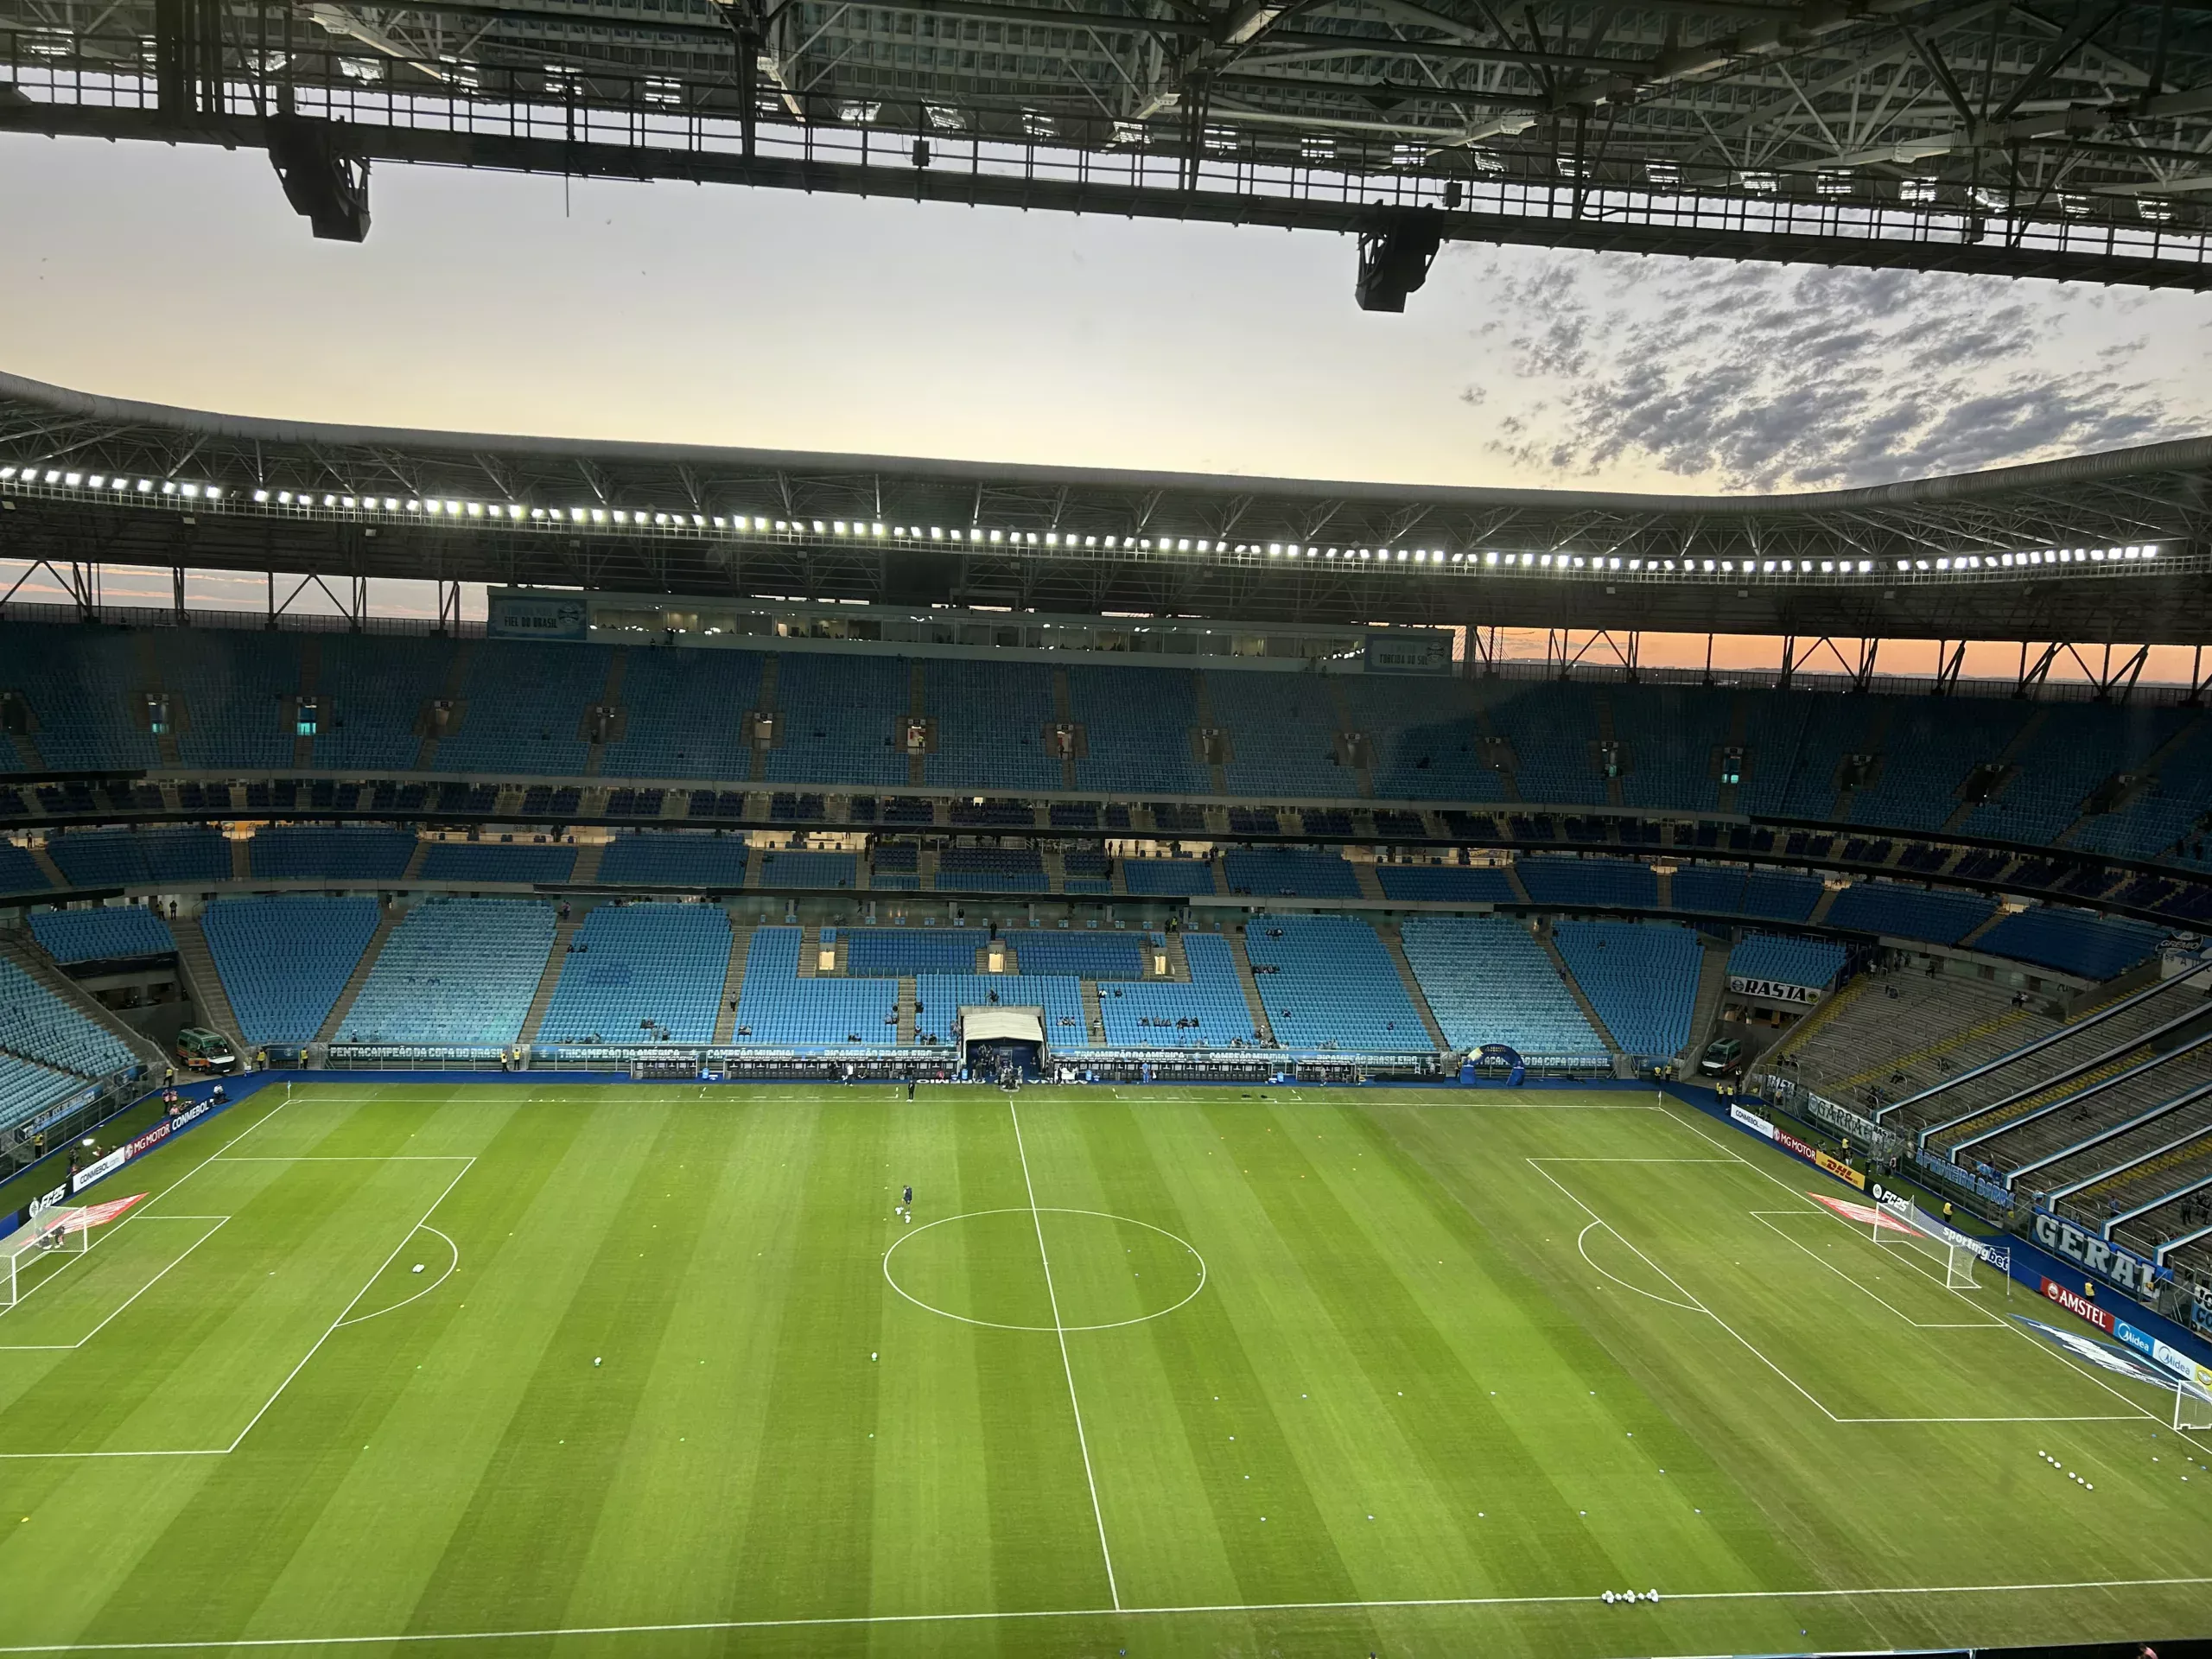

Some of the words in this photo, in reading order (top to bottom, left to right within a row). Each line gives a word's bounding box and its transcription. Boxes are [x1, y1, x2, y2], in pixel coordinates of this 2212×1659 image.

[533, 617, 557, 628] BRASIL
[1745, 979, 1806, 1002] RASTA
[330, 1046, 413, 1058] PENTACAMPEÃO
[414, 1047, 427, 1058] DA
[429, 1047, 454, 1058] COPA
[456, 1047, 469, 1058] DO
[558, 1047, 622, 1059] TRICAMPEÃO
[636, 1046, 681, 1058] AMÉRICA
[1367, 1055, 1417, 1065] BRASILEIRO
[1534, 1056, 1542, 1066] DA
[1544, 1056, 1567, 1066] COPA
[1567, 1057, 1580, 1066] DO
[1580, 1057, 1610, 1067] BRASIL
[172, 1101, 209, 1131] CONMEBOL
[134, 1138, 146, 1154] MG
[146, 1123, 170, 1145] MOTOR
[1781, 1133, 1792, 1147] MG
[1791, 1141, 1816, 1161] MOTOR
[1826, 1159, 1853, 1181] DHL
[2036, 1214, 2161, 1300] GERAL
[2059, 1289, 2106, 1329] AMSTEL
[2120, 1325, 2150, 1352] Midea
[2160, 1348, 2191, 1376] Midea
